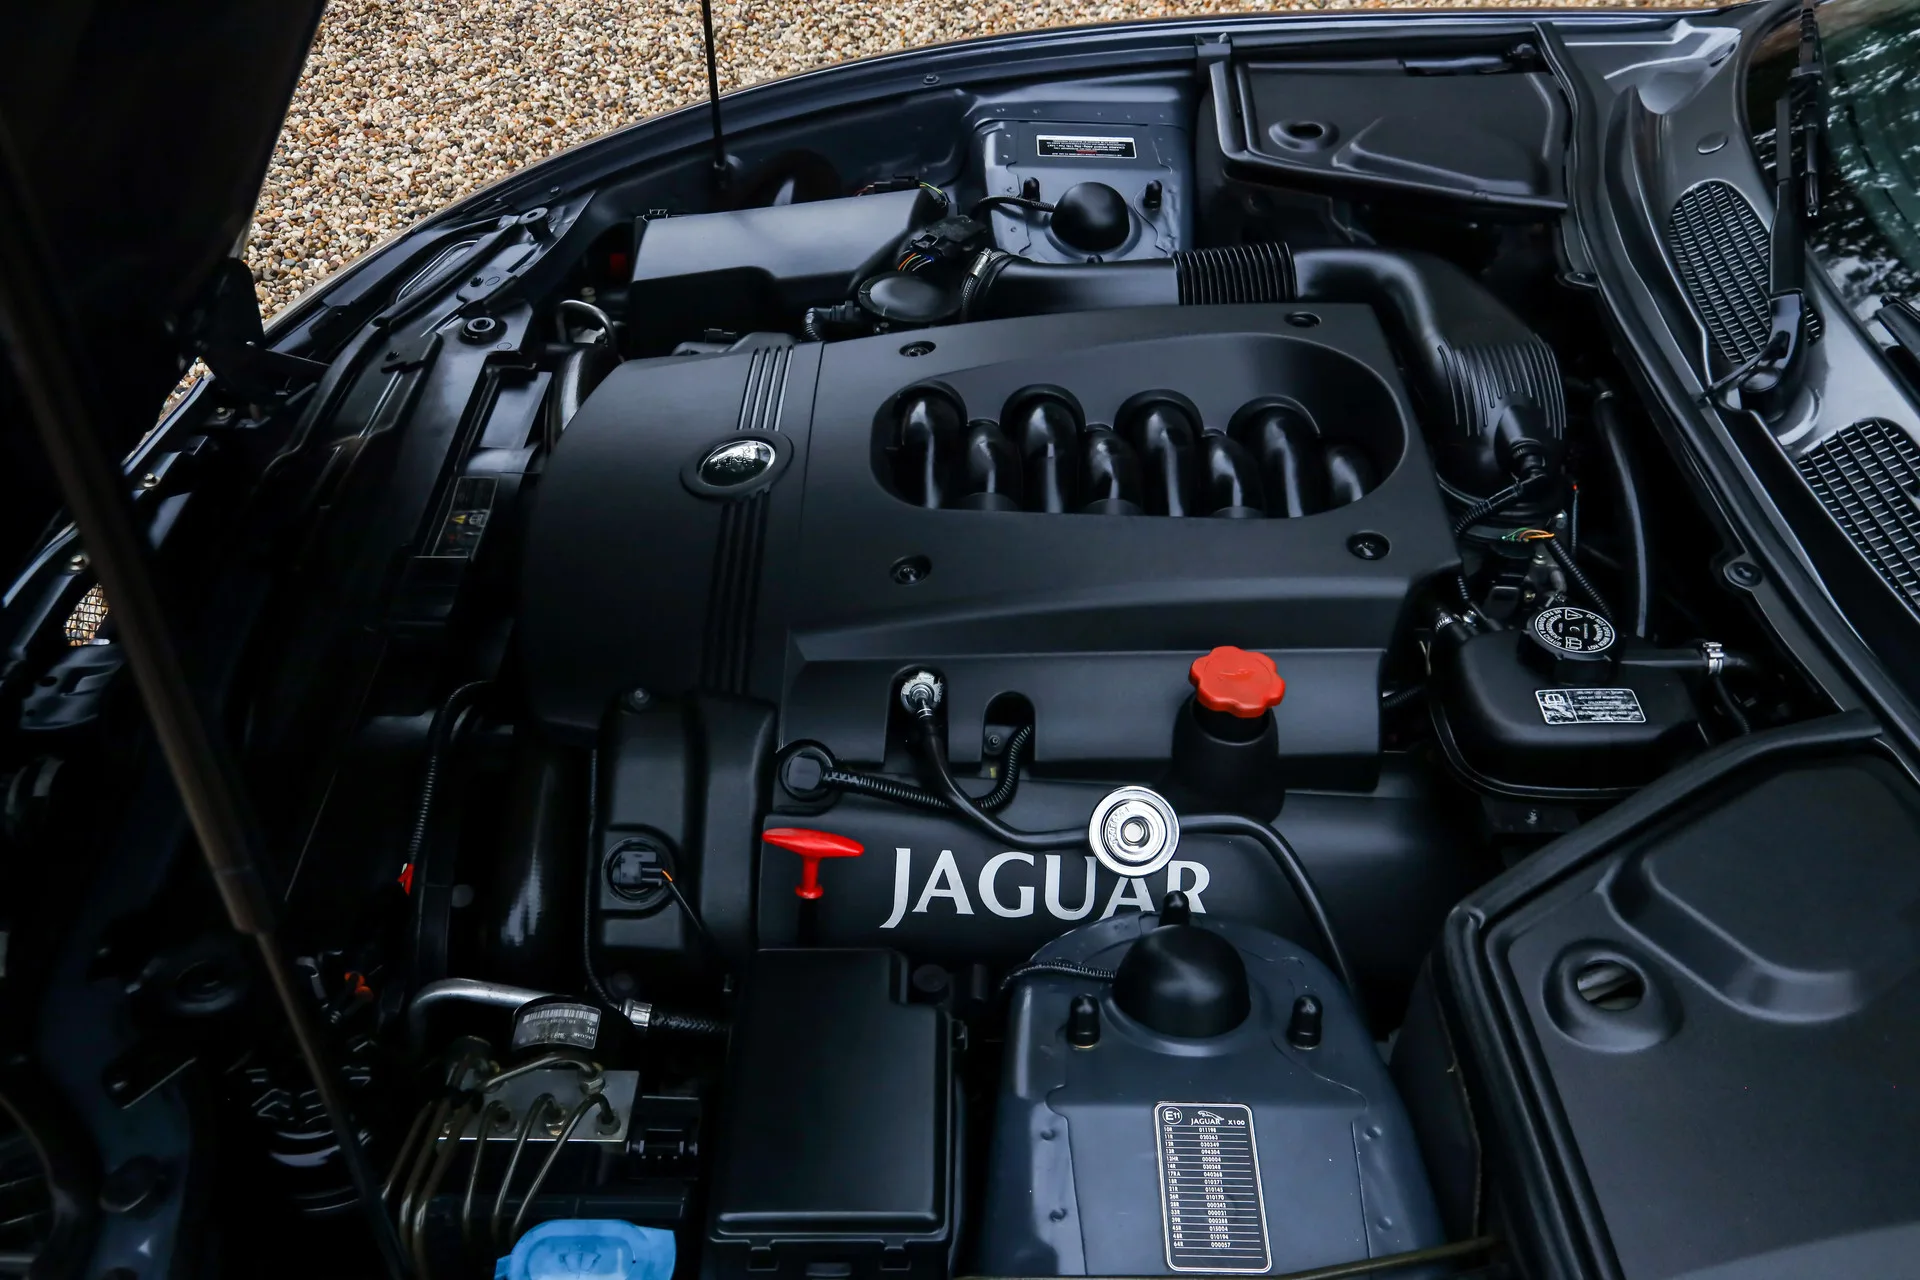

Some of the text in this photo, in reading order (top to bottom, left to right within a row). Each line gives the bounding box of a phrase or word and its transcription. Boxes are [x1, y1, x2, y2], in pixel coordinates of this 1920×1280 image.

[1594, 618, 1606, 628] NOT
[1543, 634, 1562, 647] CHAUD
[880, 848, 1211, 929] JAGUAR
